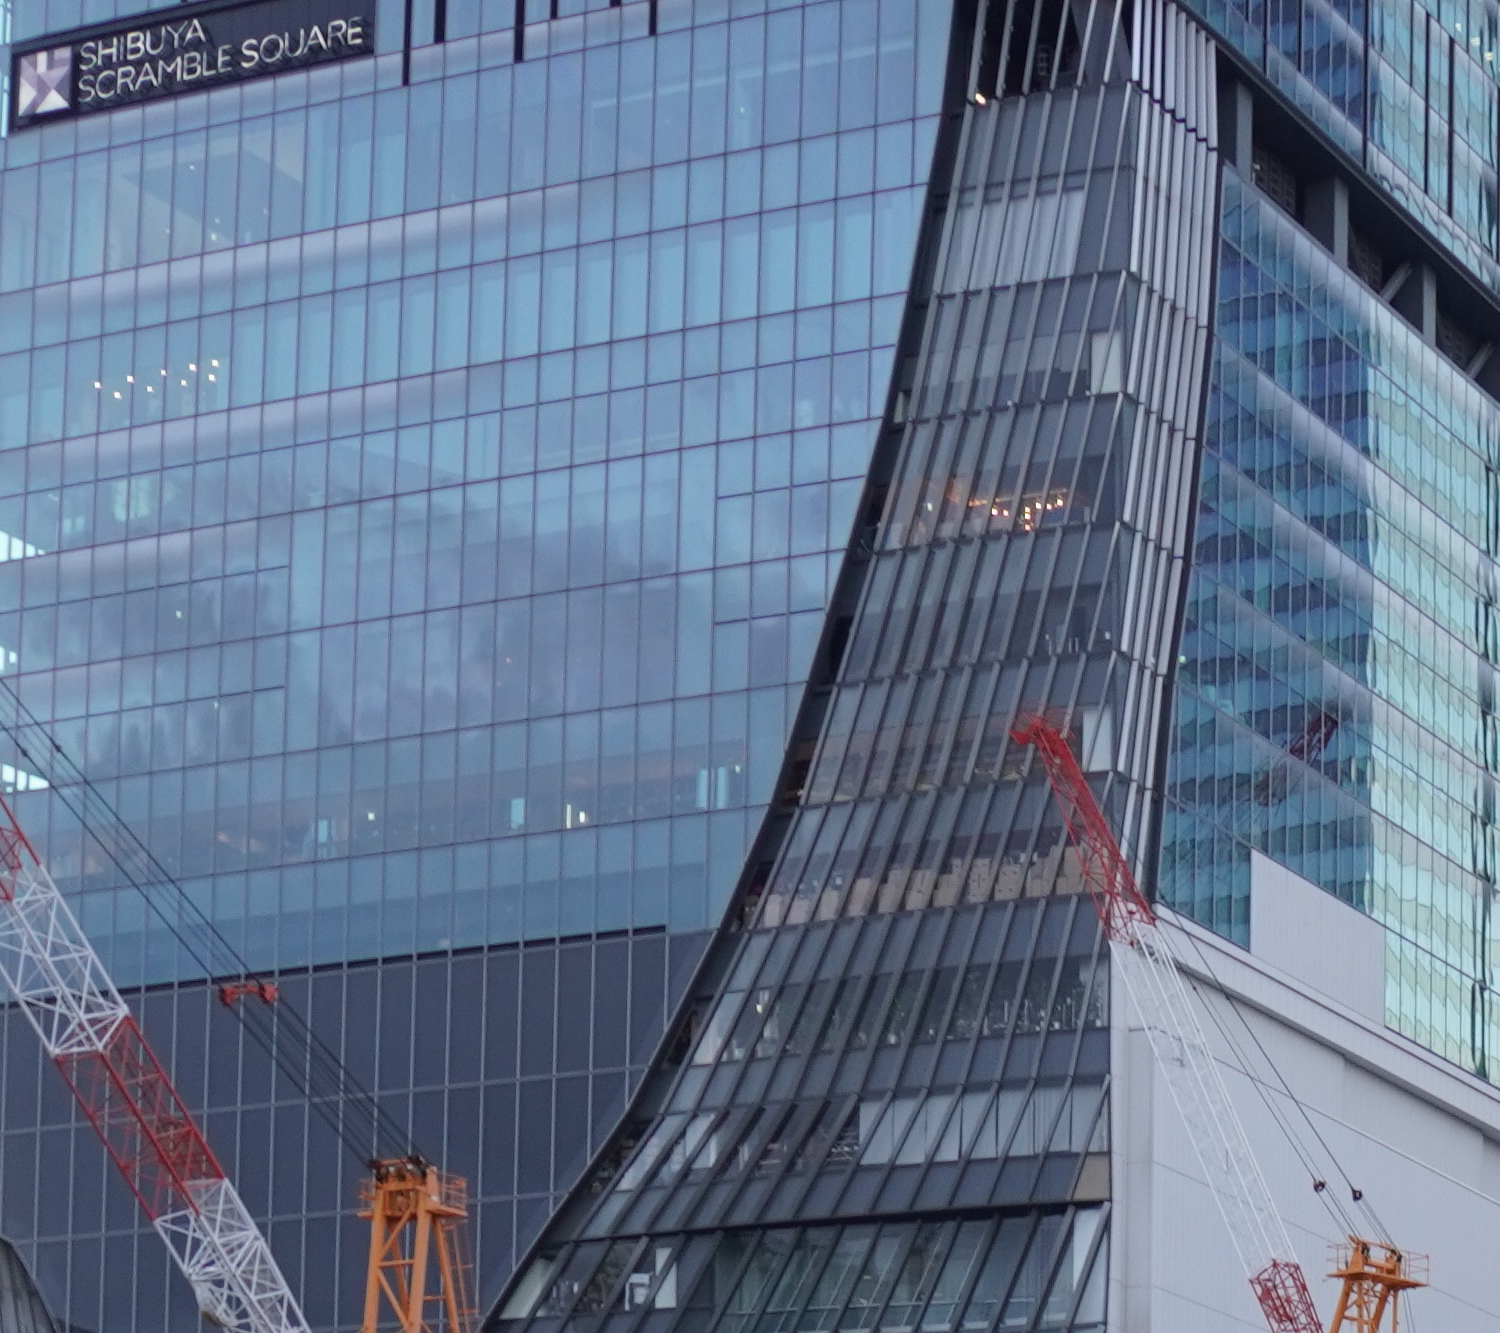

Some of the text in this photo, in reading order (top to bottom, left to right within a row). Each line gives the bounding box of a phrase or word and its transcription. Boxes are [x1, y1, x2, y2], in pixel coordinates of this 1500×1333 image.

[77, 16, 364, 103] SCRAMBLE SQUARE
[78, 18, 207, 71] SHIBUYA
